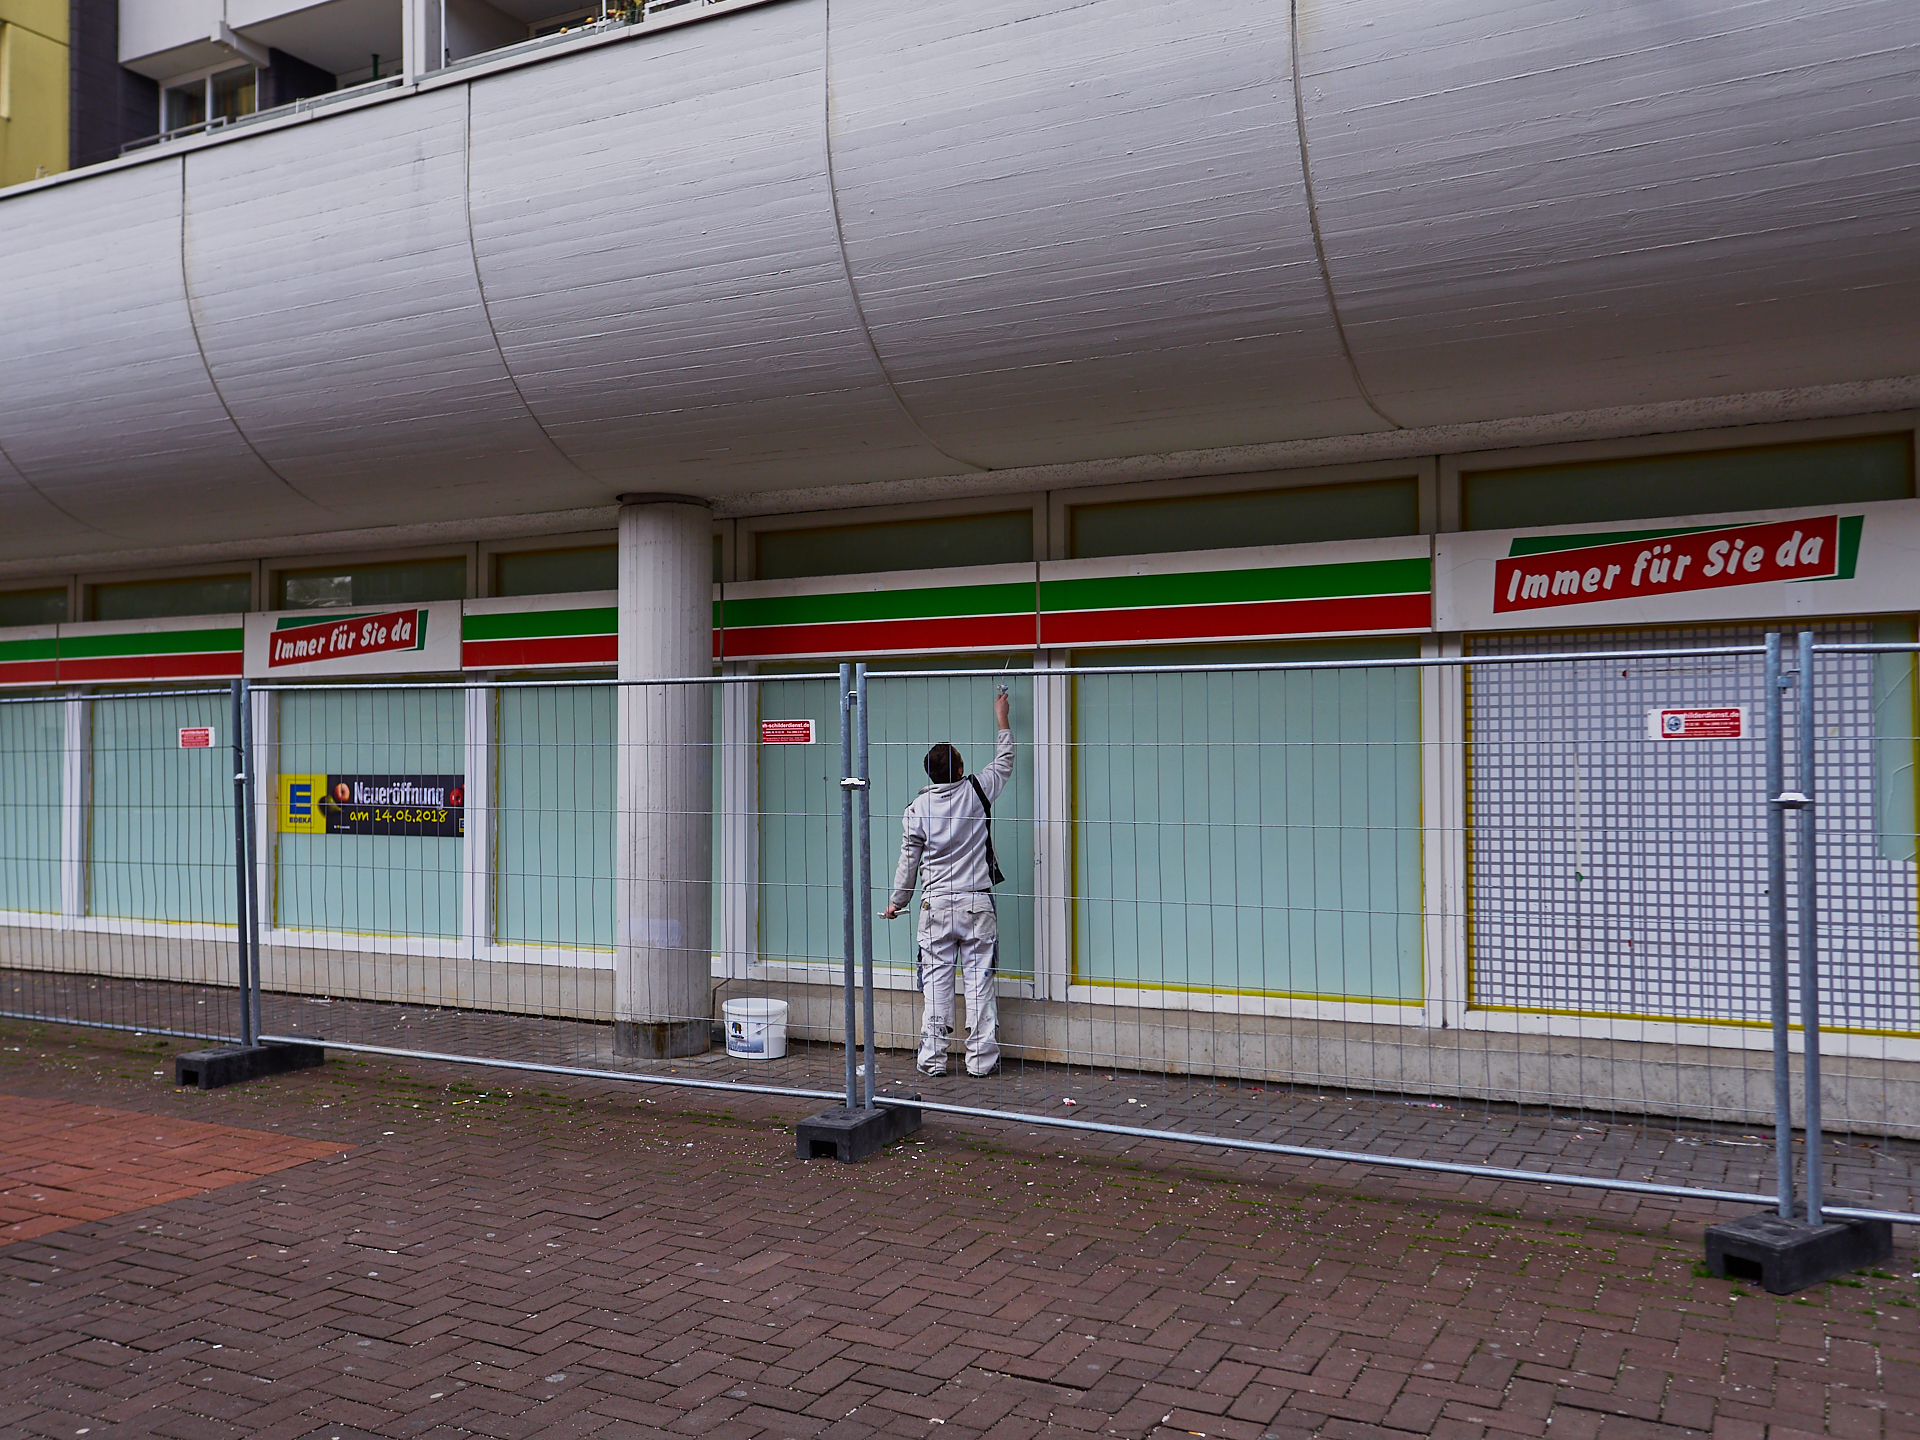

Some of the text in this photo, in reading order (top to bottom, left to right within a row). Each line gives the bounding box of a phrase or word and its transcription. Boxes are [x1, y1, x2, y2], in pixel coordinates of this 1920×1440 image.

[1507, 530, 1824, 602] Immer für Sie da
[274, 617, 411, 661] Immer für Sie da
[354, 781, 444, 810] Neueröffnung
[350, 809, 448, 823] am 14.06.2018
